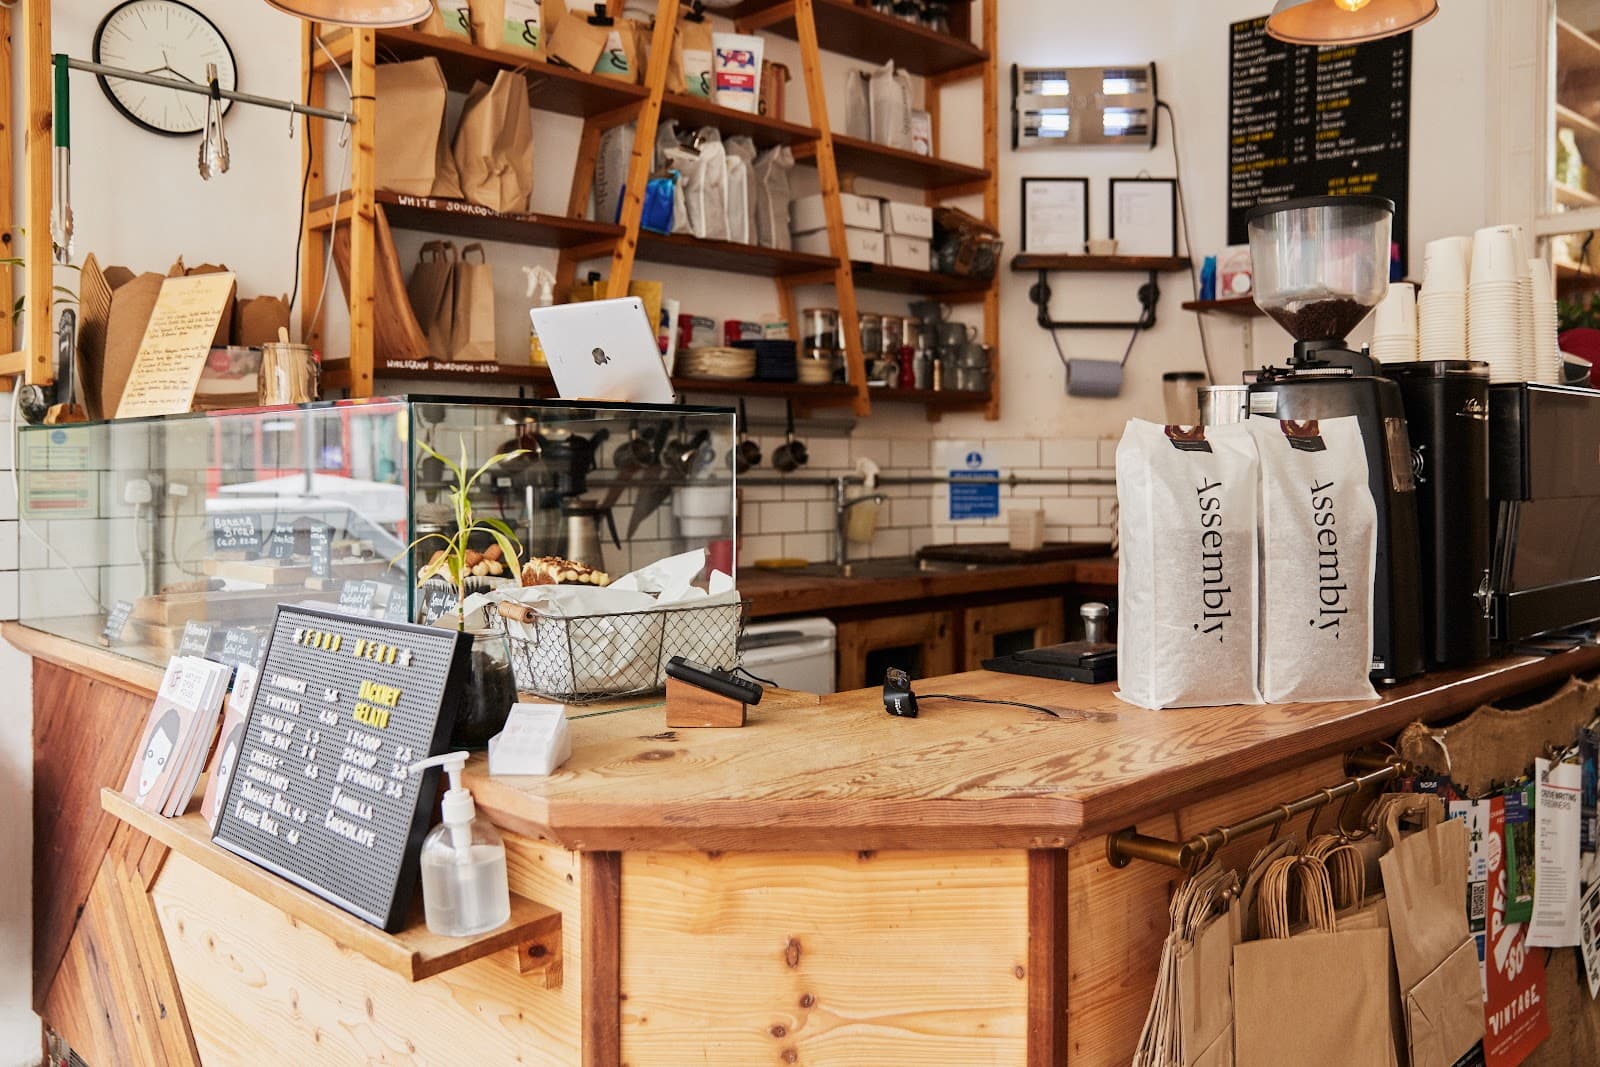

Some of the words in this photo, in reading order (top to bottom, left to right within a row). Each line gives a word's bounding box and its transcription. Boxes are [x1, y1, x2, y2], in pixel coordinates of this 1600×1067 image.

[398, 196, 437, 209] WHITE
[215, 515, 254, 530] Banana
[223, 524, 255, 539] Bread
[1193, 477, 1232, 643] Assembly
[1310, 479, 1348, 641] Assembly
[304, 628, 342, 653] FOOD
[354, 639, 399, 665] MENU
[359, 680, 402, 708] HACKNEY
[353, 702, 390, 729] GELATO
[336, 763, 385, 792] AFFOGATO
[325, 808, 376, 848] CHOCOLATE
[1488, 983, 1541, 1036] VINTAGE
